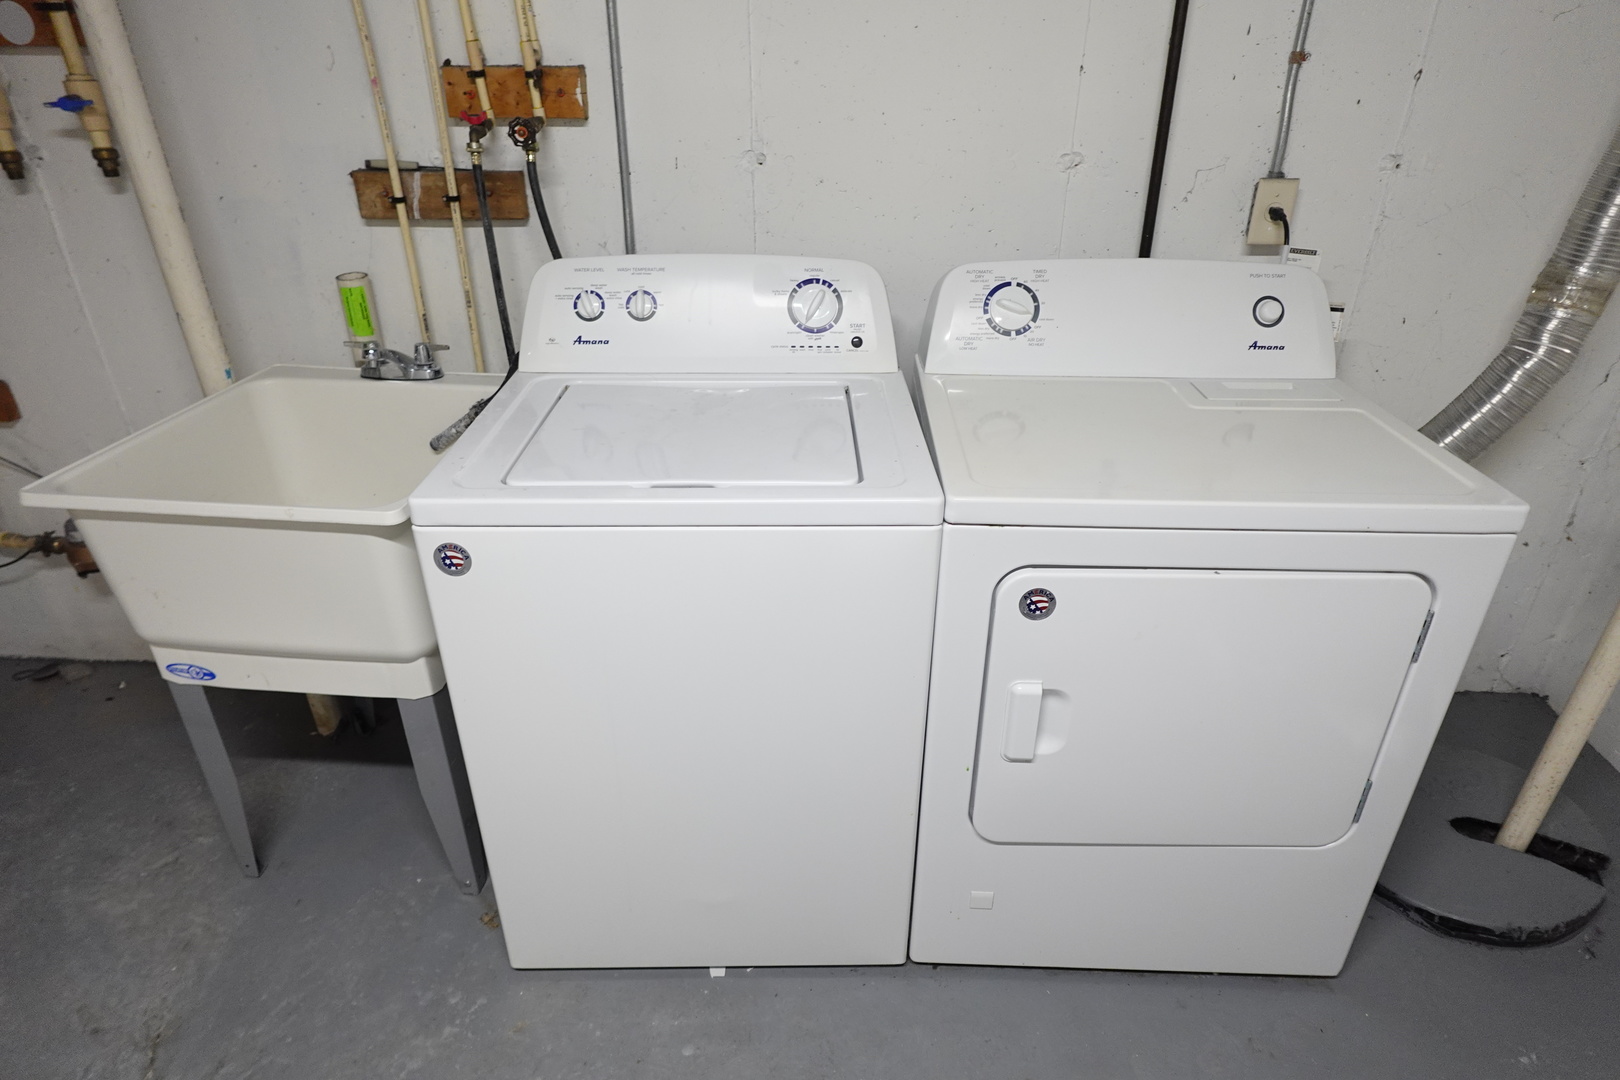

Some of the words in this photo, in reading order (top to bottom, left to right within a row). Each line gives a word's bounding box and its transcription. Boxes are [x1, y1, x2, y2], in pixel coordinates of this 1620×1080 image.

[573, 335, 610, 345] Amana
[1248, 341, 1285, 350] Amana
[438, 544, 470, 560] AMERICA
[1024, 589, 1055, 602] AMERICA
